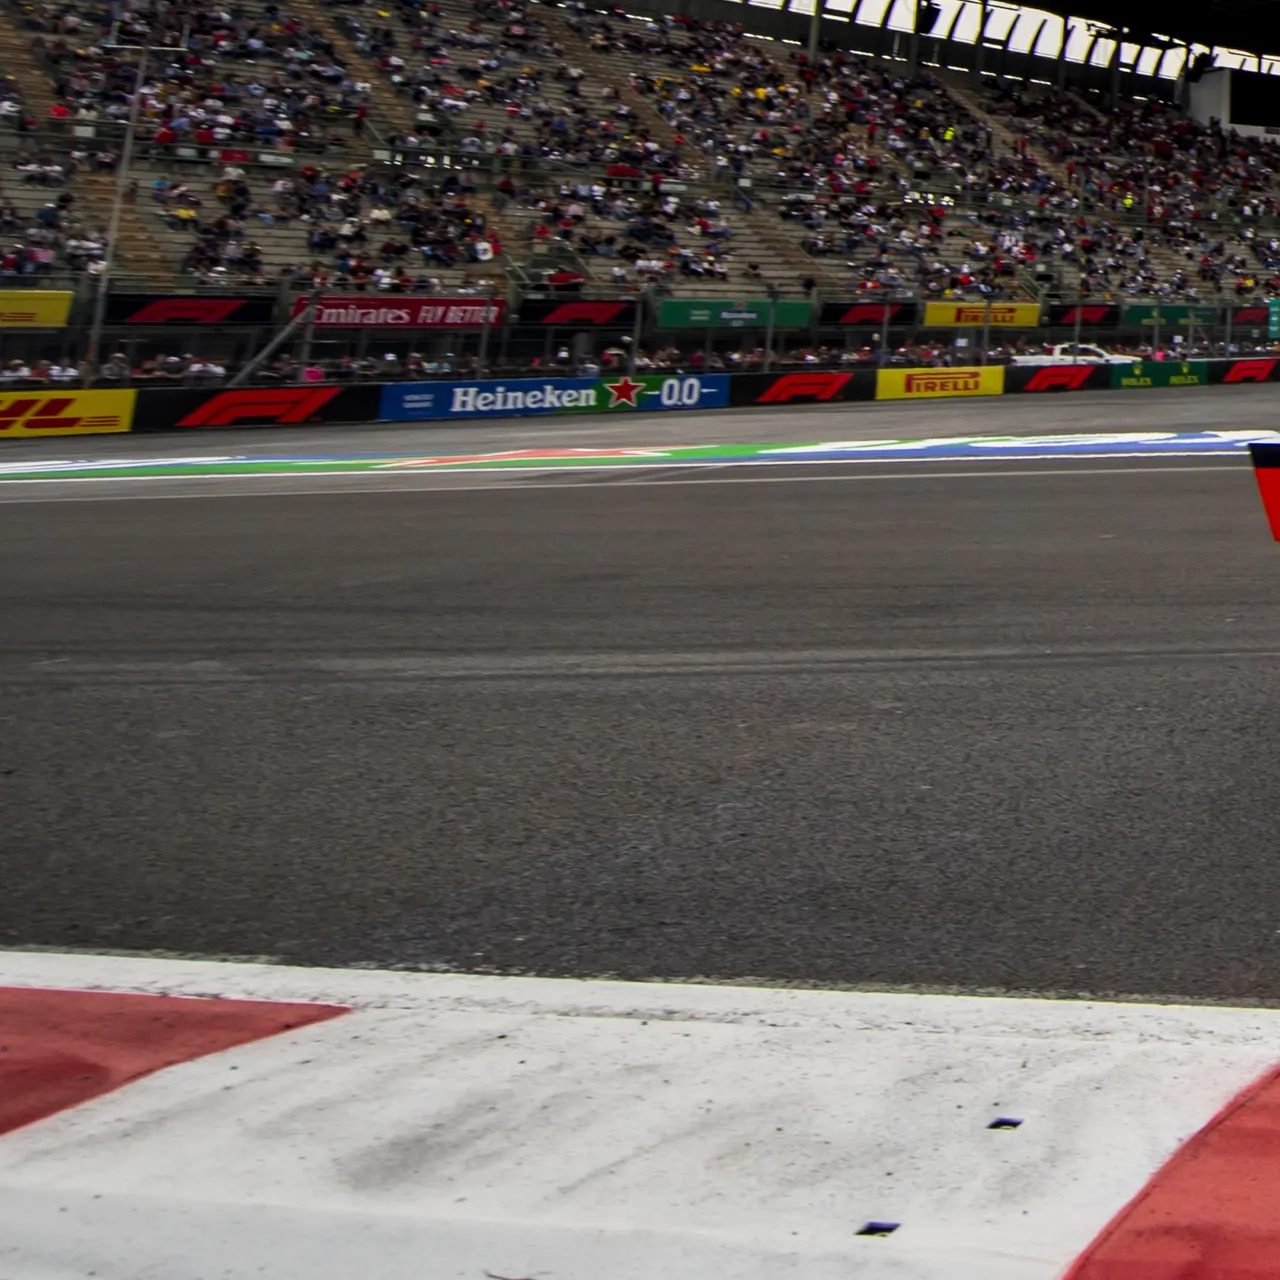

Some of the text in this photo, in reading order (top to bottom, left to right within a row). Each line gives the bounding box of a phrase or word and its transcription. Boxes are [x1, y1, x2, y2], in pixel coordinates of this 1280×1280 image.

[955, 307, 1017, 323] PIRLLI
[904, 371, 981, 394] PIRELLI
[449, 385, 598, 412] Heineken
